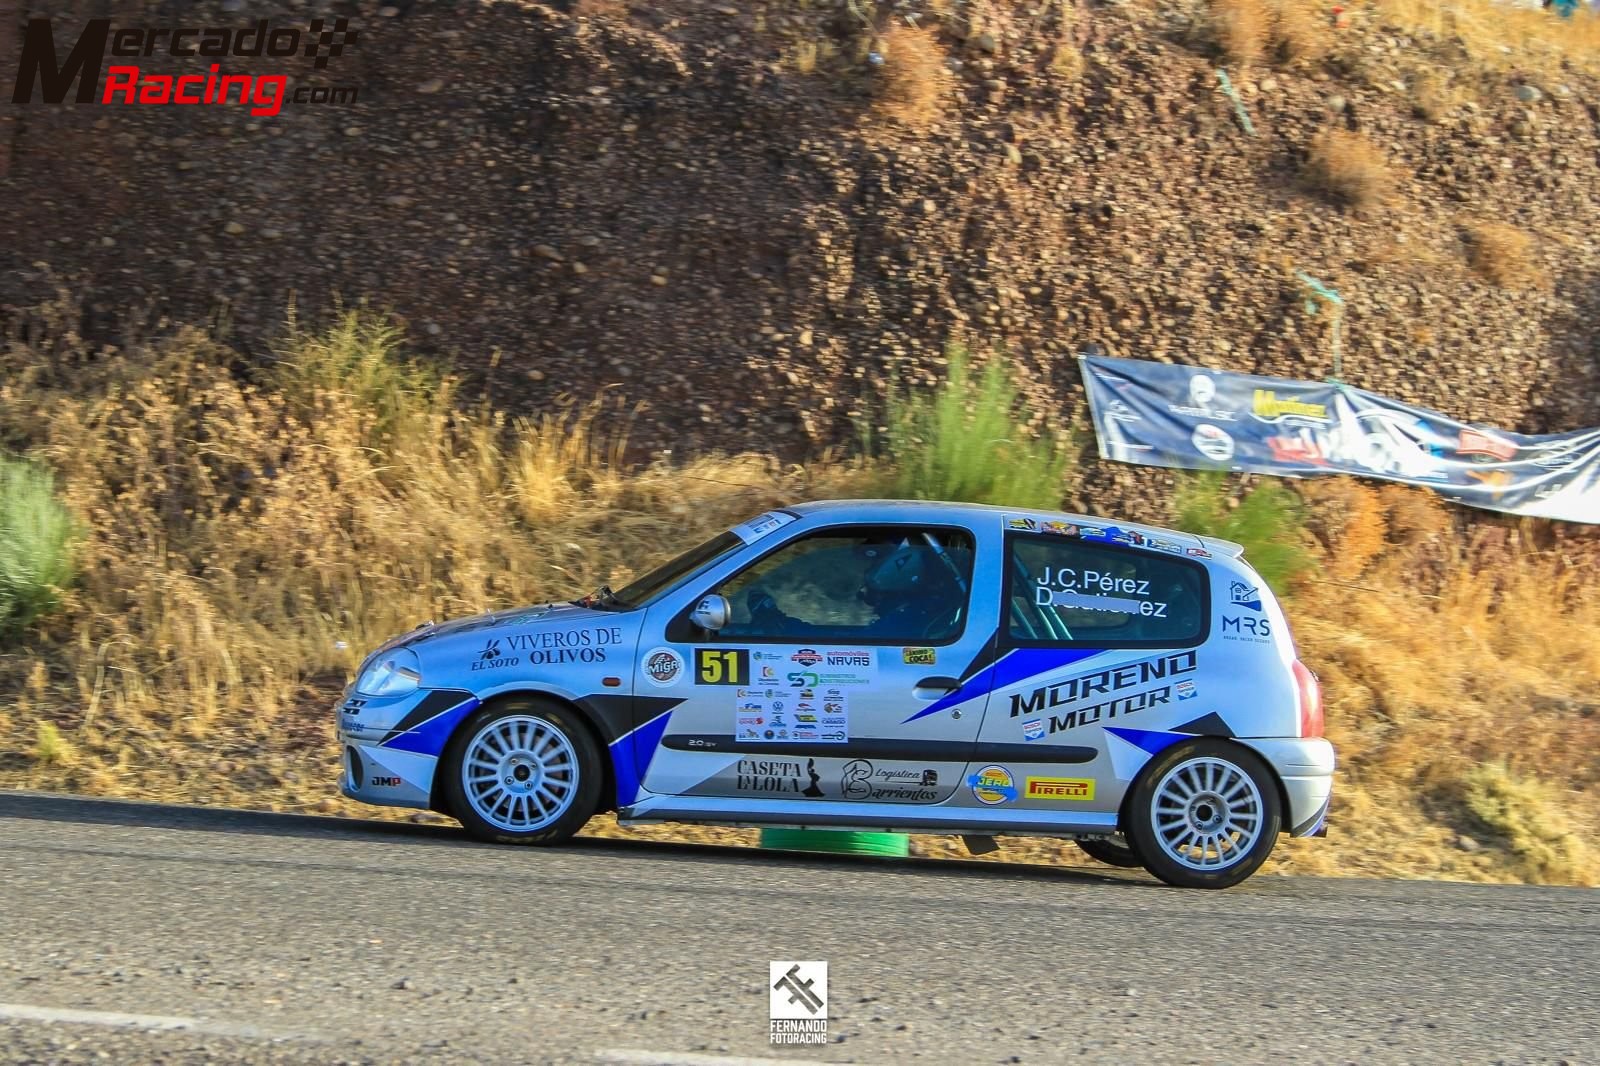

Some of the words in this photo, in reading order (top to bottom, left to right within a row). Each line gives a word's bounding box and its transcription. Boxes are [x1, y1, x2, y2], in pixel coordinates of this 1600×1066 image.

[1222, 615, 1271, 637] MRS
[506, 630, 591, 650] VIVEROS
[596, 627, 623, 645] DE
[471, 661, 487, 671] EL
[488, 657, 520, 669] SOTO
[530, 647, 606, 664] OLIVOS
[827, 657, 870, 667] NAVAS
[702, 651, 738, 683] 51
[1009, 650, 1197, 718] MORENO
[1048, 686, 1171, 734] MOTOR
[737, 760, 801, 777] CASETA
[372, 776, 401, 786] JMP
[752, 776, 799, 792] LOLA
[1029, 781, 1088, 796] PIRELLI
